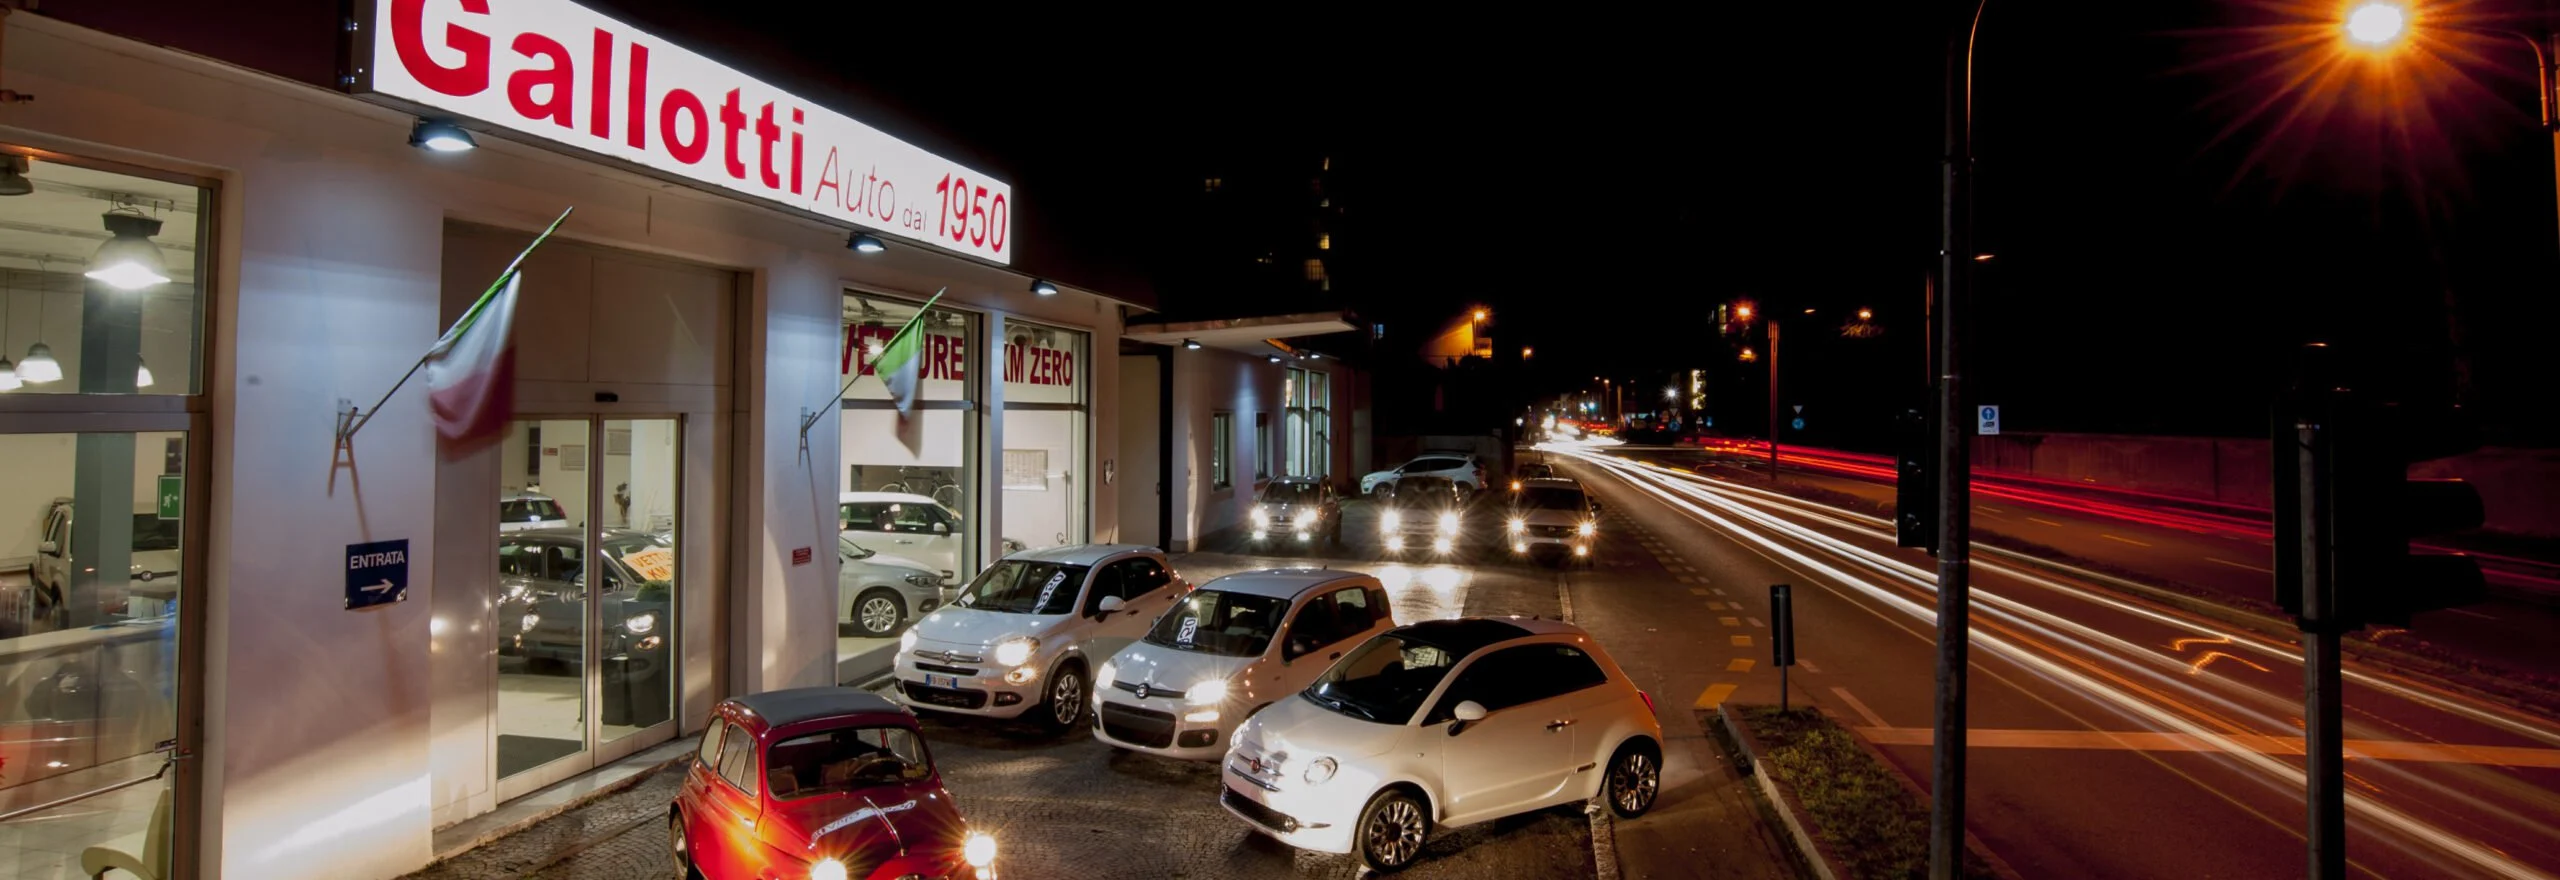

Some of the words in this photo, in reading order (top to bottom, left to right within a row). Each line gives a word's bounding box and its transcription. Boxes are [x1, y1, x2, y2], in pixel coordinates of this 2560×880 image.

[390, 0, 804, 195] Gallotti
[813, 145, 895, 222] Auto
[902, 202, 927, 233] dal
[936, 172, 1006, 252] 1950
[842, 323, 964, 380] VETURE
[1030, 346, 1073, 387] ZERO
[350, 550, 405, 569] ENTRATA
